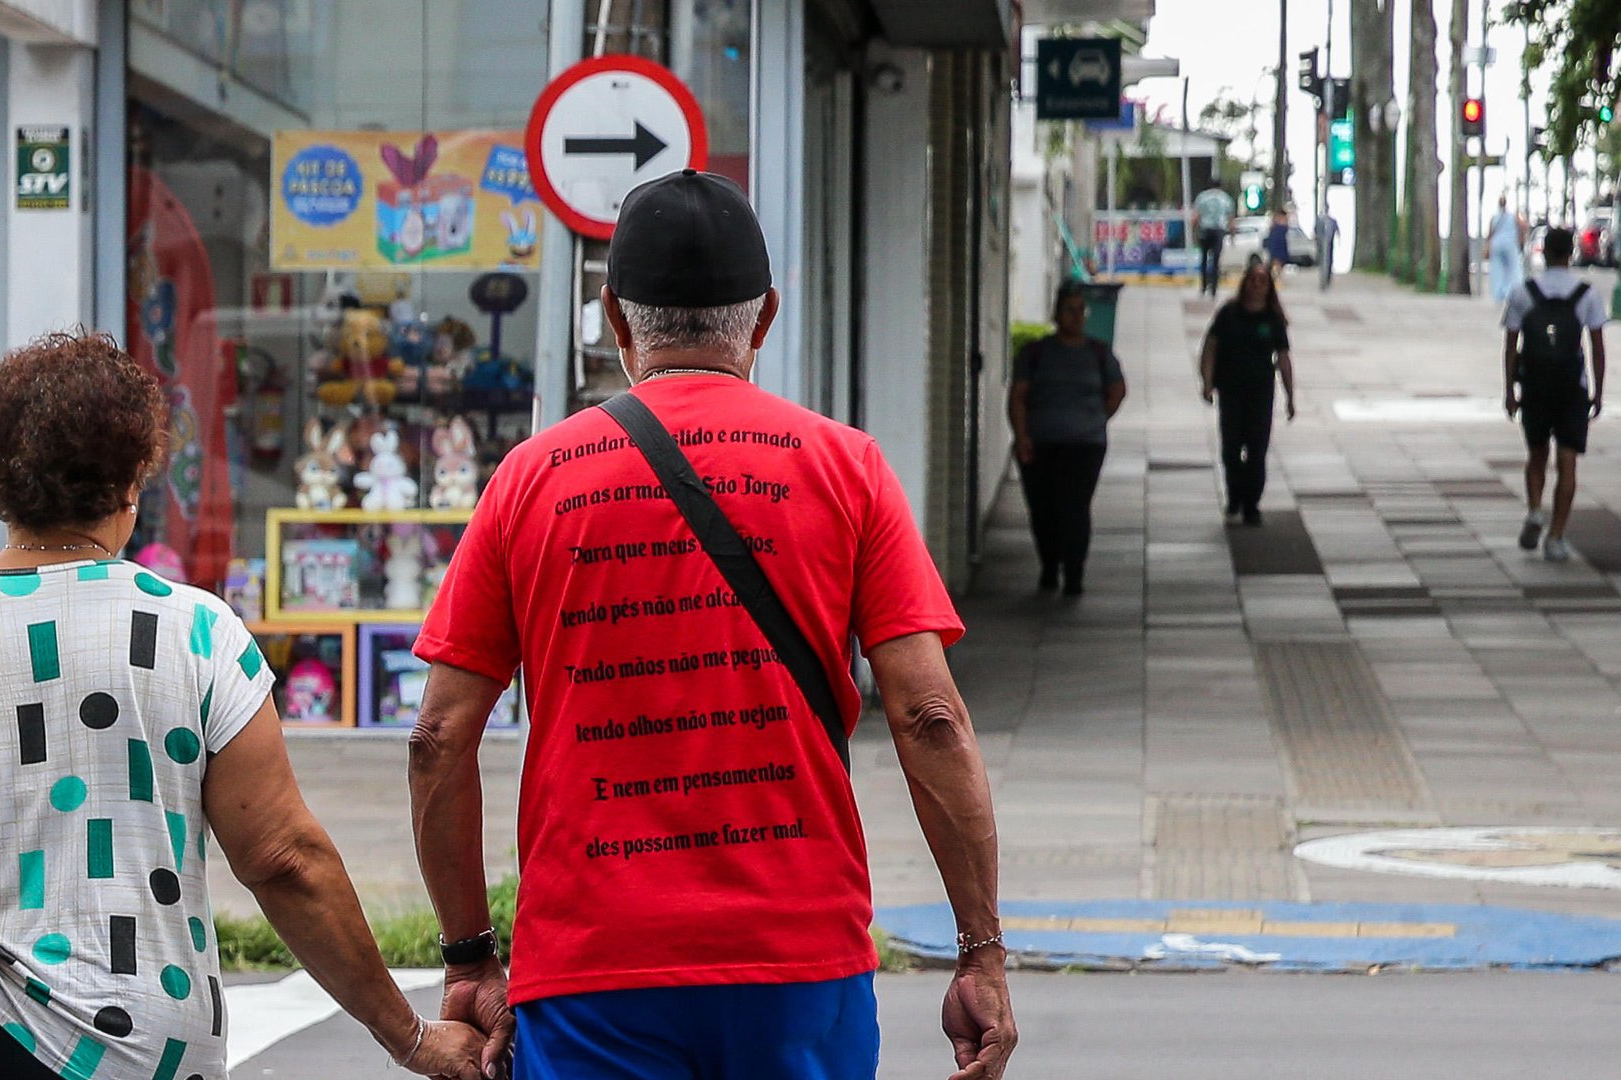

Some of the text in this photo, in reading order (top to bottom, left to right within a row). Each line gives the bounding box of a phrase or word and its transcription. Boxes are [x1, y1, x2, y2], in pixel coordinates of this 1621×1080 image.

[549, 448, 572, 468] Eu
[575, 436, 638, 459] andare
[718, 429, 727, 443] e
[730, 428, 802, 449] armado
[555, 493, 587, 516] com
[589, 487, 611, 505] as
[703, 475, 737, 498] São
[740, 473, 791, 504] Jorge
[570, 538, 698, 566] Para que meus
[560, 601, 608, 629] tendo
[609, 597, 640, 626] pés
[642, 595, 677, 616] não
[679, 596, 702, 612] me
[564, 648, 783, 685] Tendo mãos não me pegue
[576, 719, 625, 743] tendo
[627, 715, 675, 738] olhos
[675, 711, 708, 732] não
[710, 710, 736, 727] me
[592, 762, 796, 801] E nem em pensamentos
[585, 817, 809, 861] eles possam me fazer mal.
